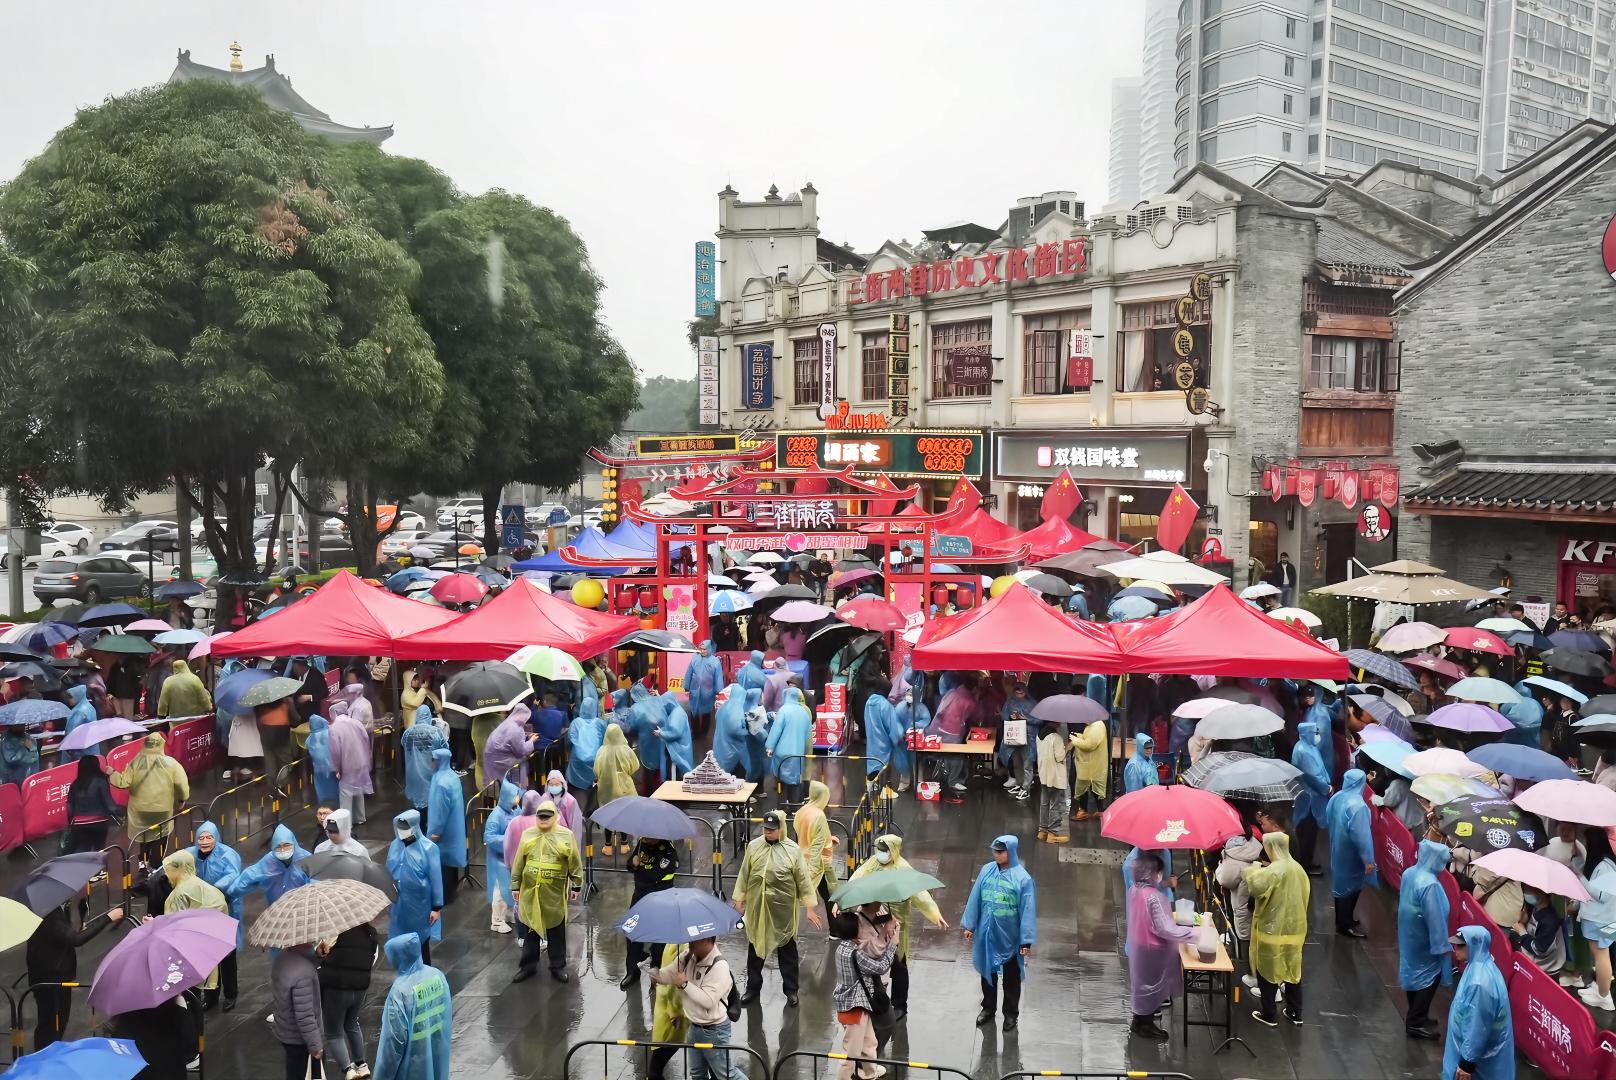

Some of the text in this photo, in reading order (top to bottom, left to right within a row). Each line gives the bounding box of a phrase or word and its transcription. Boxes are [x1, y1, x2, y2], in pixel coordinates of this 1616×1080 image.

[848, 237, 1088, 304] 三街两巷历史文化街区
[821, 328, 835, 337] 1945
[1561, 539, 1616, 563] KF
[528, 866, 560, 878] POICE
